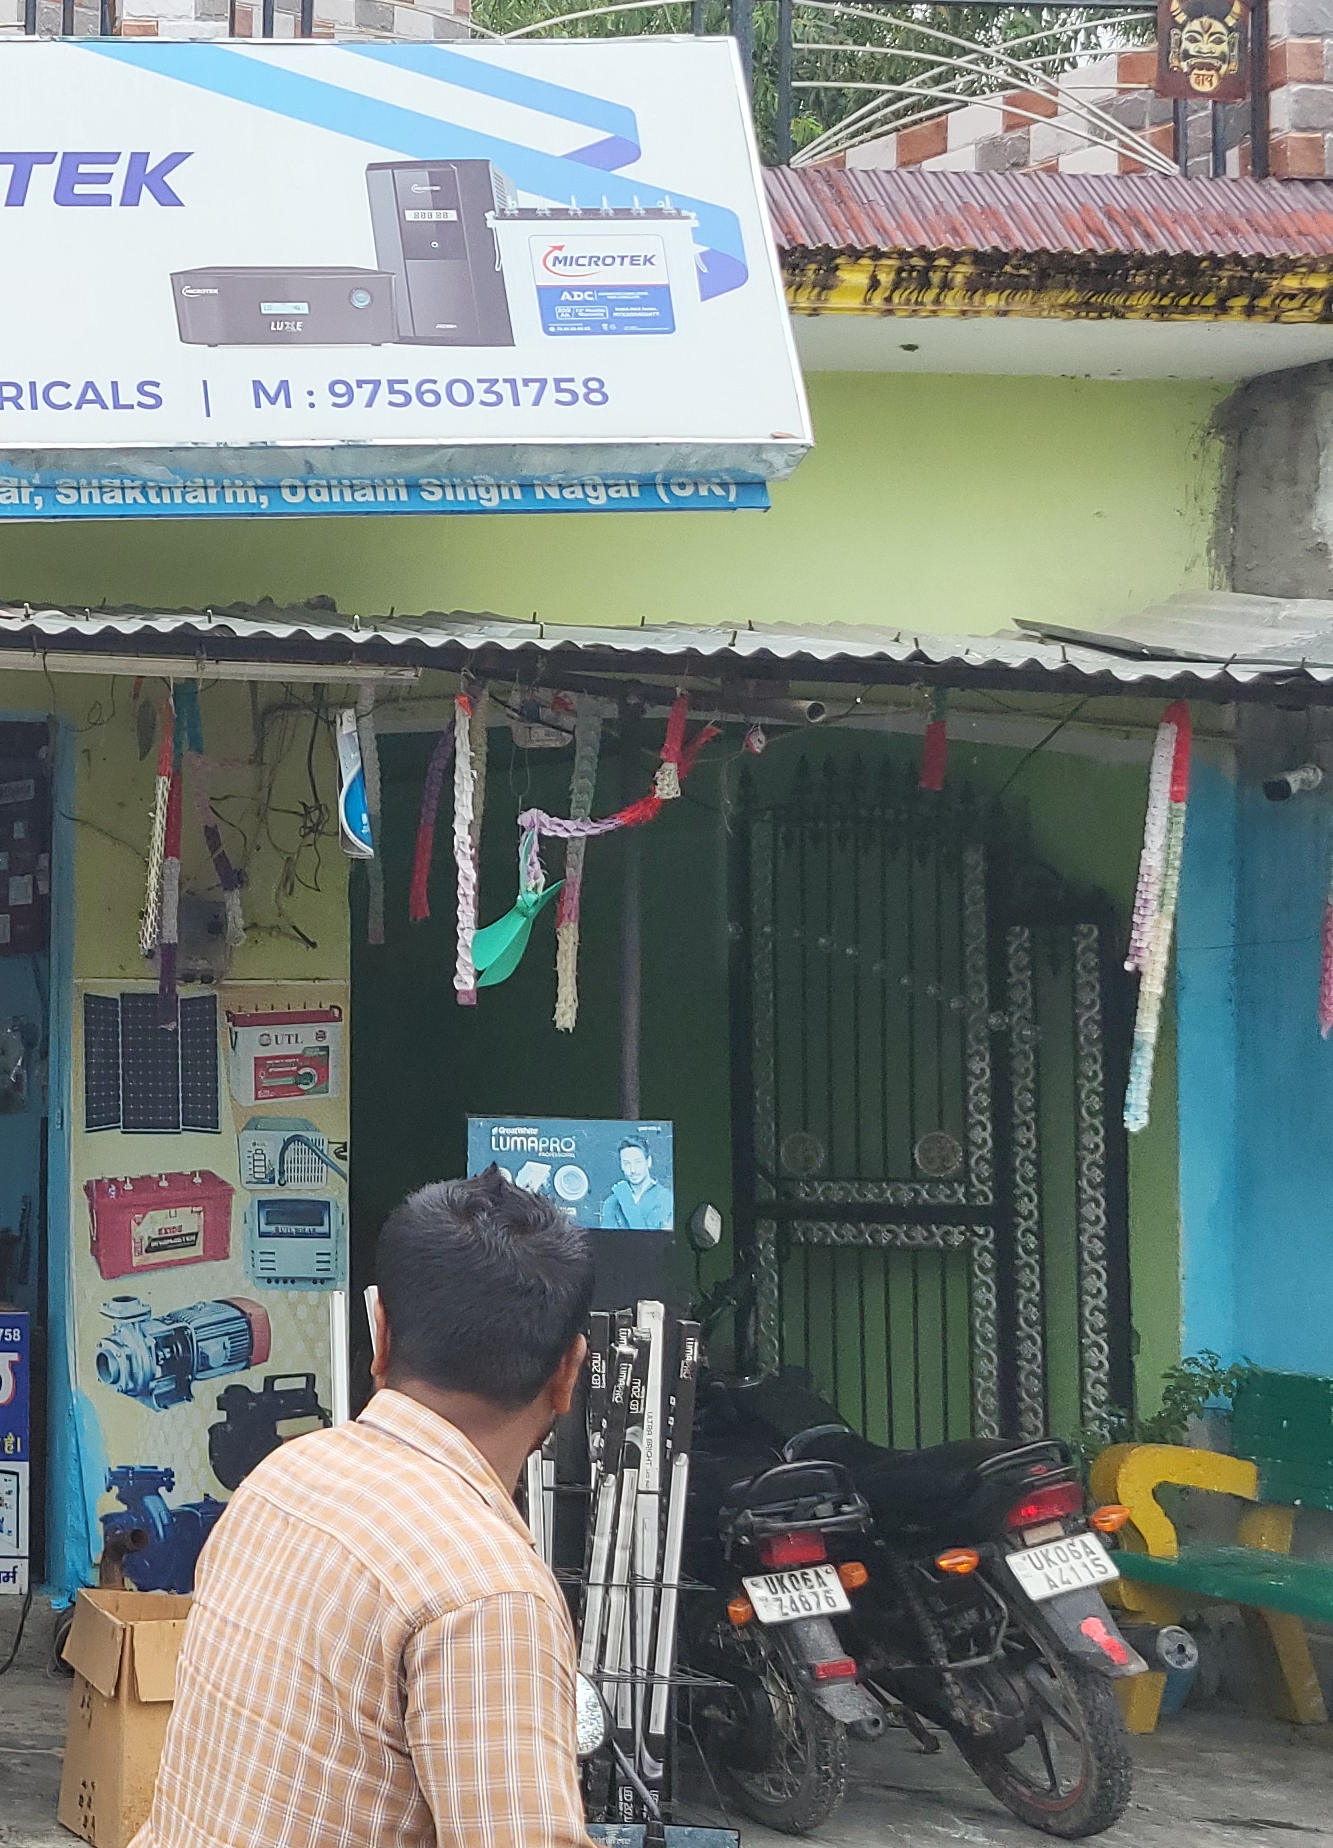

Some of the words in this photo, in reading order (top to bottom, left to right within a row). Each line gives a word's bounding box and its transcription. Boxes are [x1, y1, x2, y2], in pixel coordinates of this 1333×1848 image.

[551, 254, 657, 268] MICROTEK
[251, 378, 293, 409] M
[329, 376, 611, 409] 9756031758
[274, 1033, 304, 1046] UTL
[490, 1135, 577, 1152] LUMAPRO
[646, 1411, 654, 1436] ULTRA
[1027, 1539, 1097, 1571] UK06A
[1043, 1557, 1109, 1591] A4115
